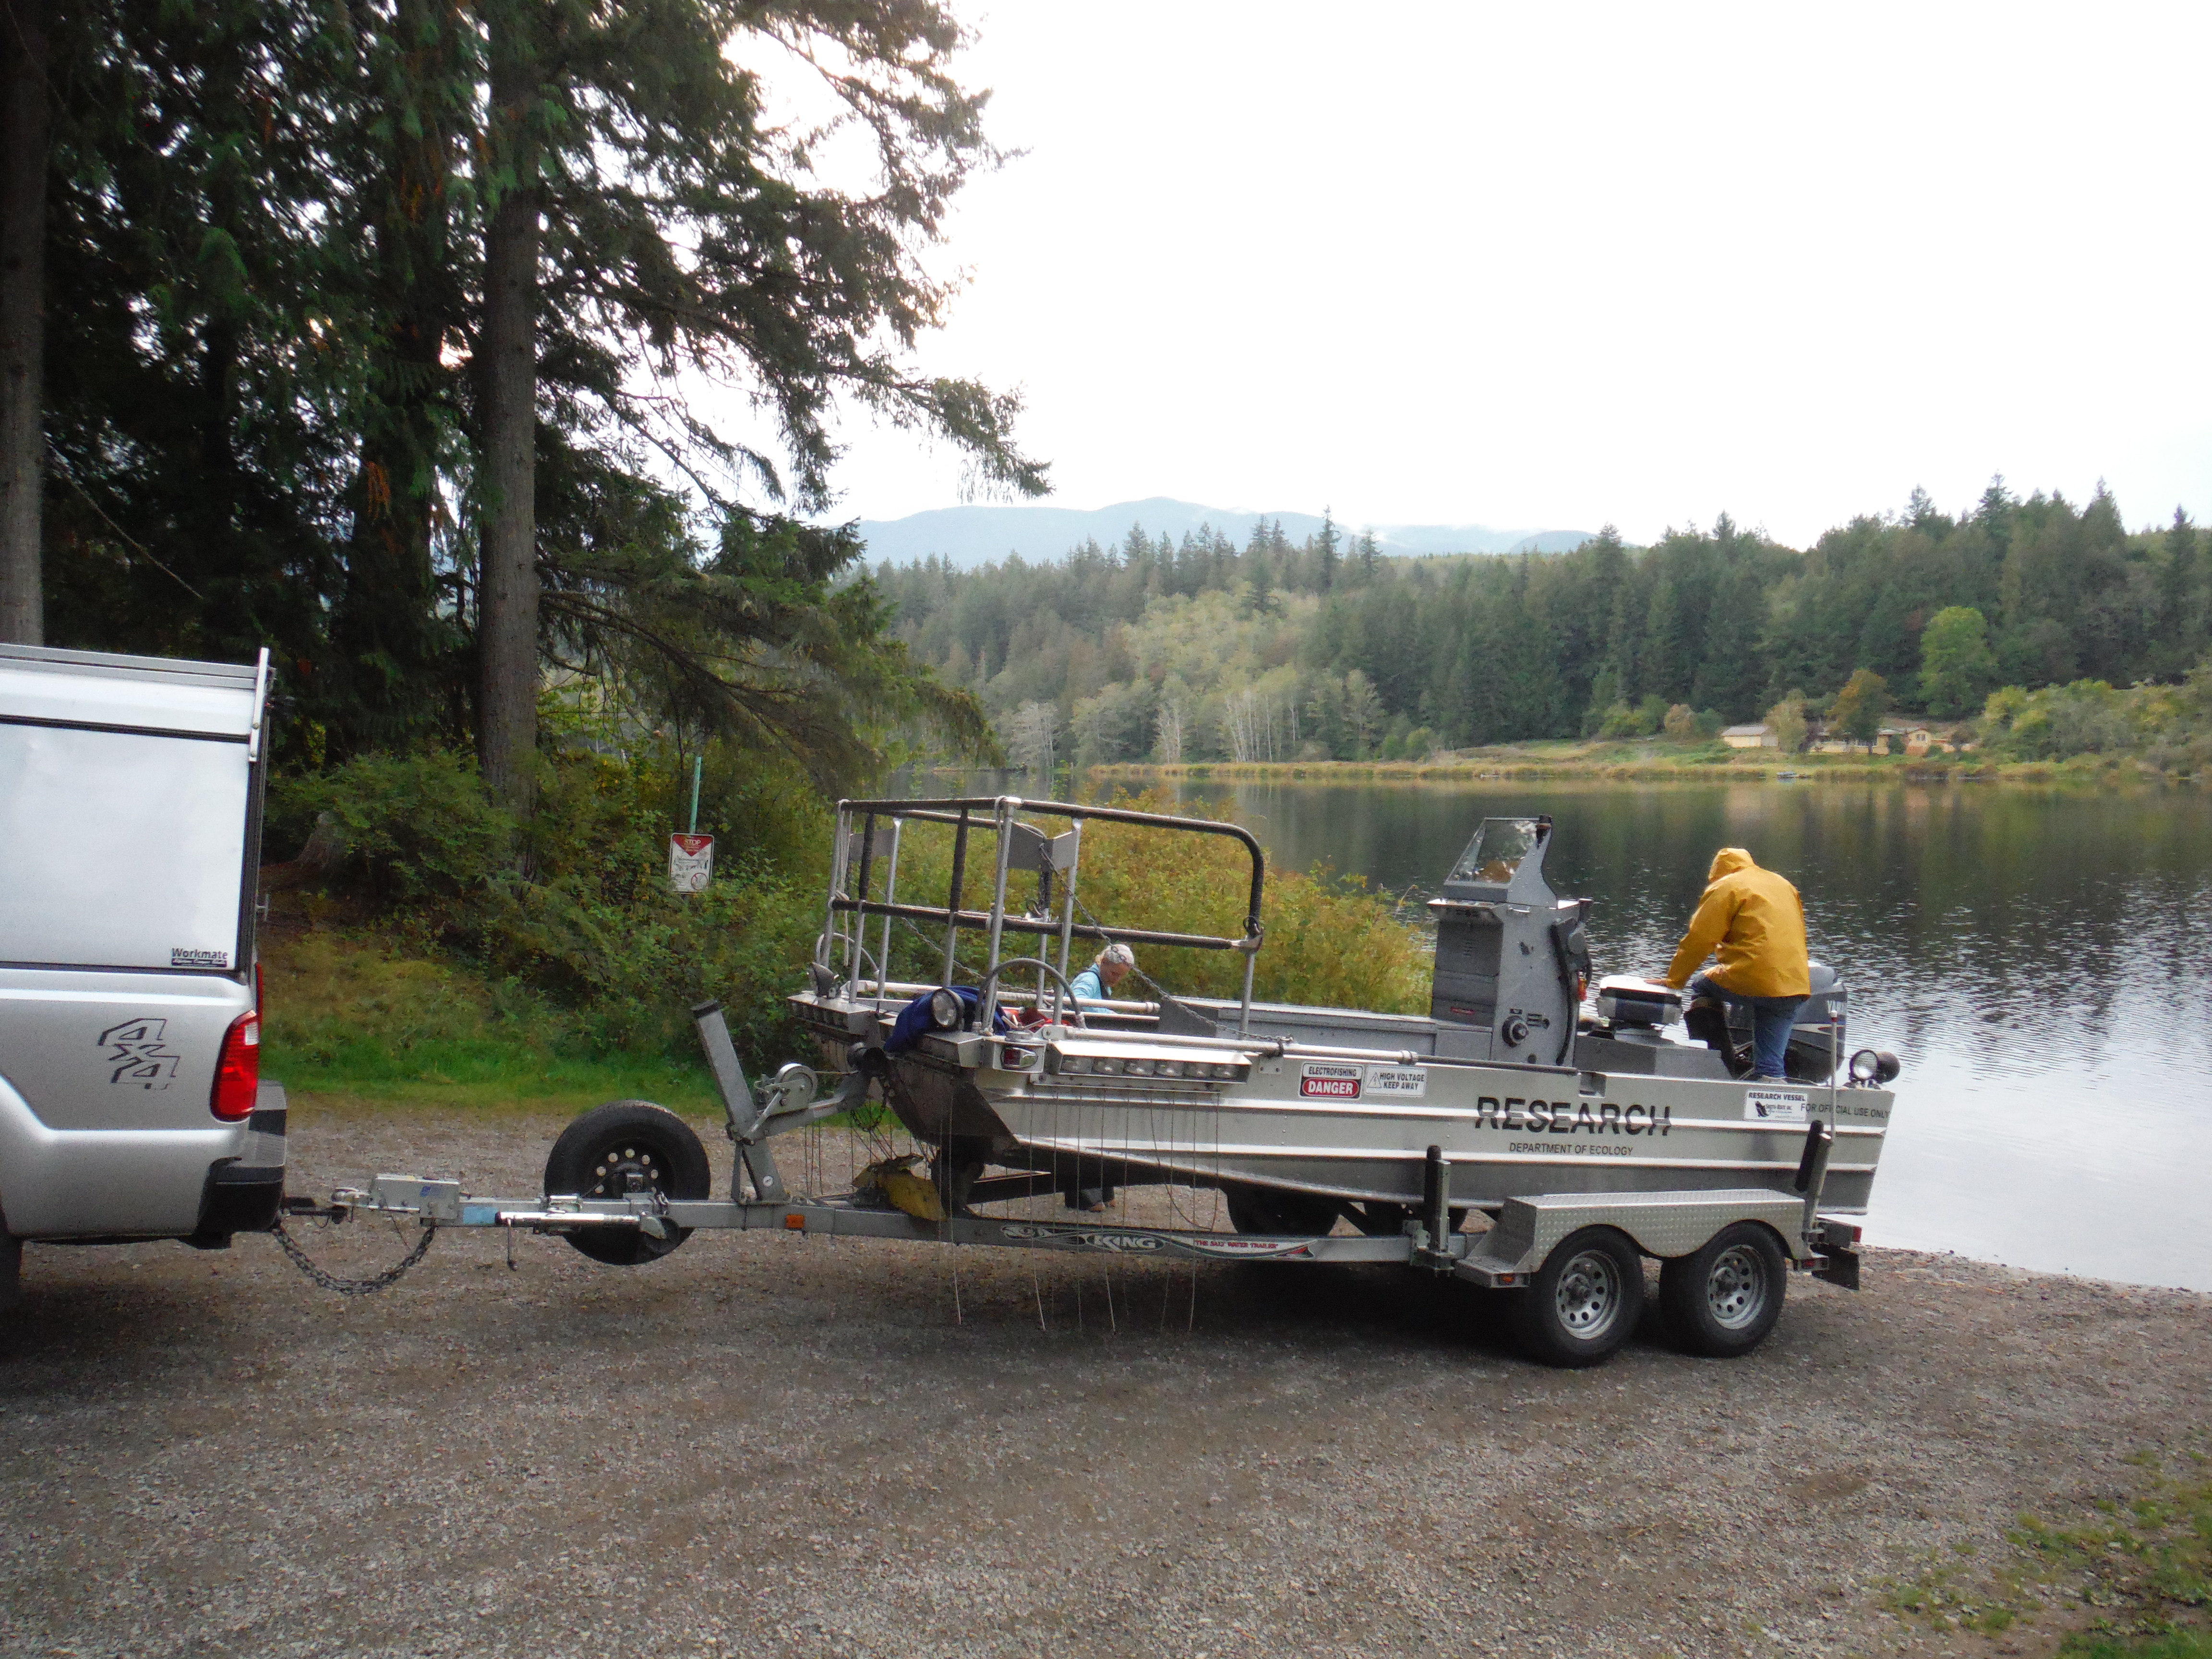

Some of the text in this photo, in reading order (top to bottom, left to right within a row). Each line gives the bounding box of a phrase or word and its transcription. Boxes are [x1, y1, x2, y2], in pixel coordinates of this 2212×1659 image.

[171, 948, 228, 959] Workmate
[1308, 1066, 1357, 1077] ELECTROFISHING
[1380, 1072, 1424, 1082] HIGH VOLTAGE
[1308, 1081, 1354, 1095] DANGER
[1383, 1081, 1419, 1091] KEEP AWAY
[1474, 1096, 1671, 1136] RESEARCH
[1801, 1103, 1816, 1112] FOR
[1854, 1107, 1869, 1117] USE
[1870, 1109, 1891, 1118] ONLY
[1509, 1142, 1634, 1156] DEPARTMENT OF ECOLOGY
[1093, 1235, 1156, 1253] KING
